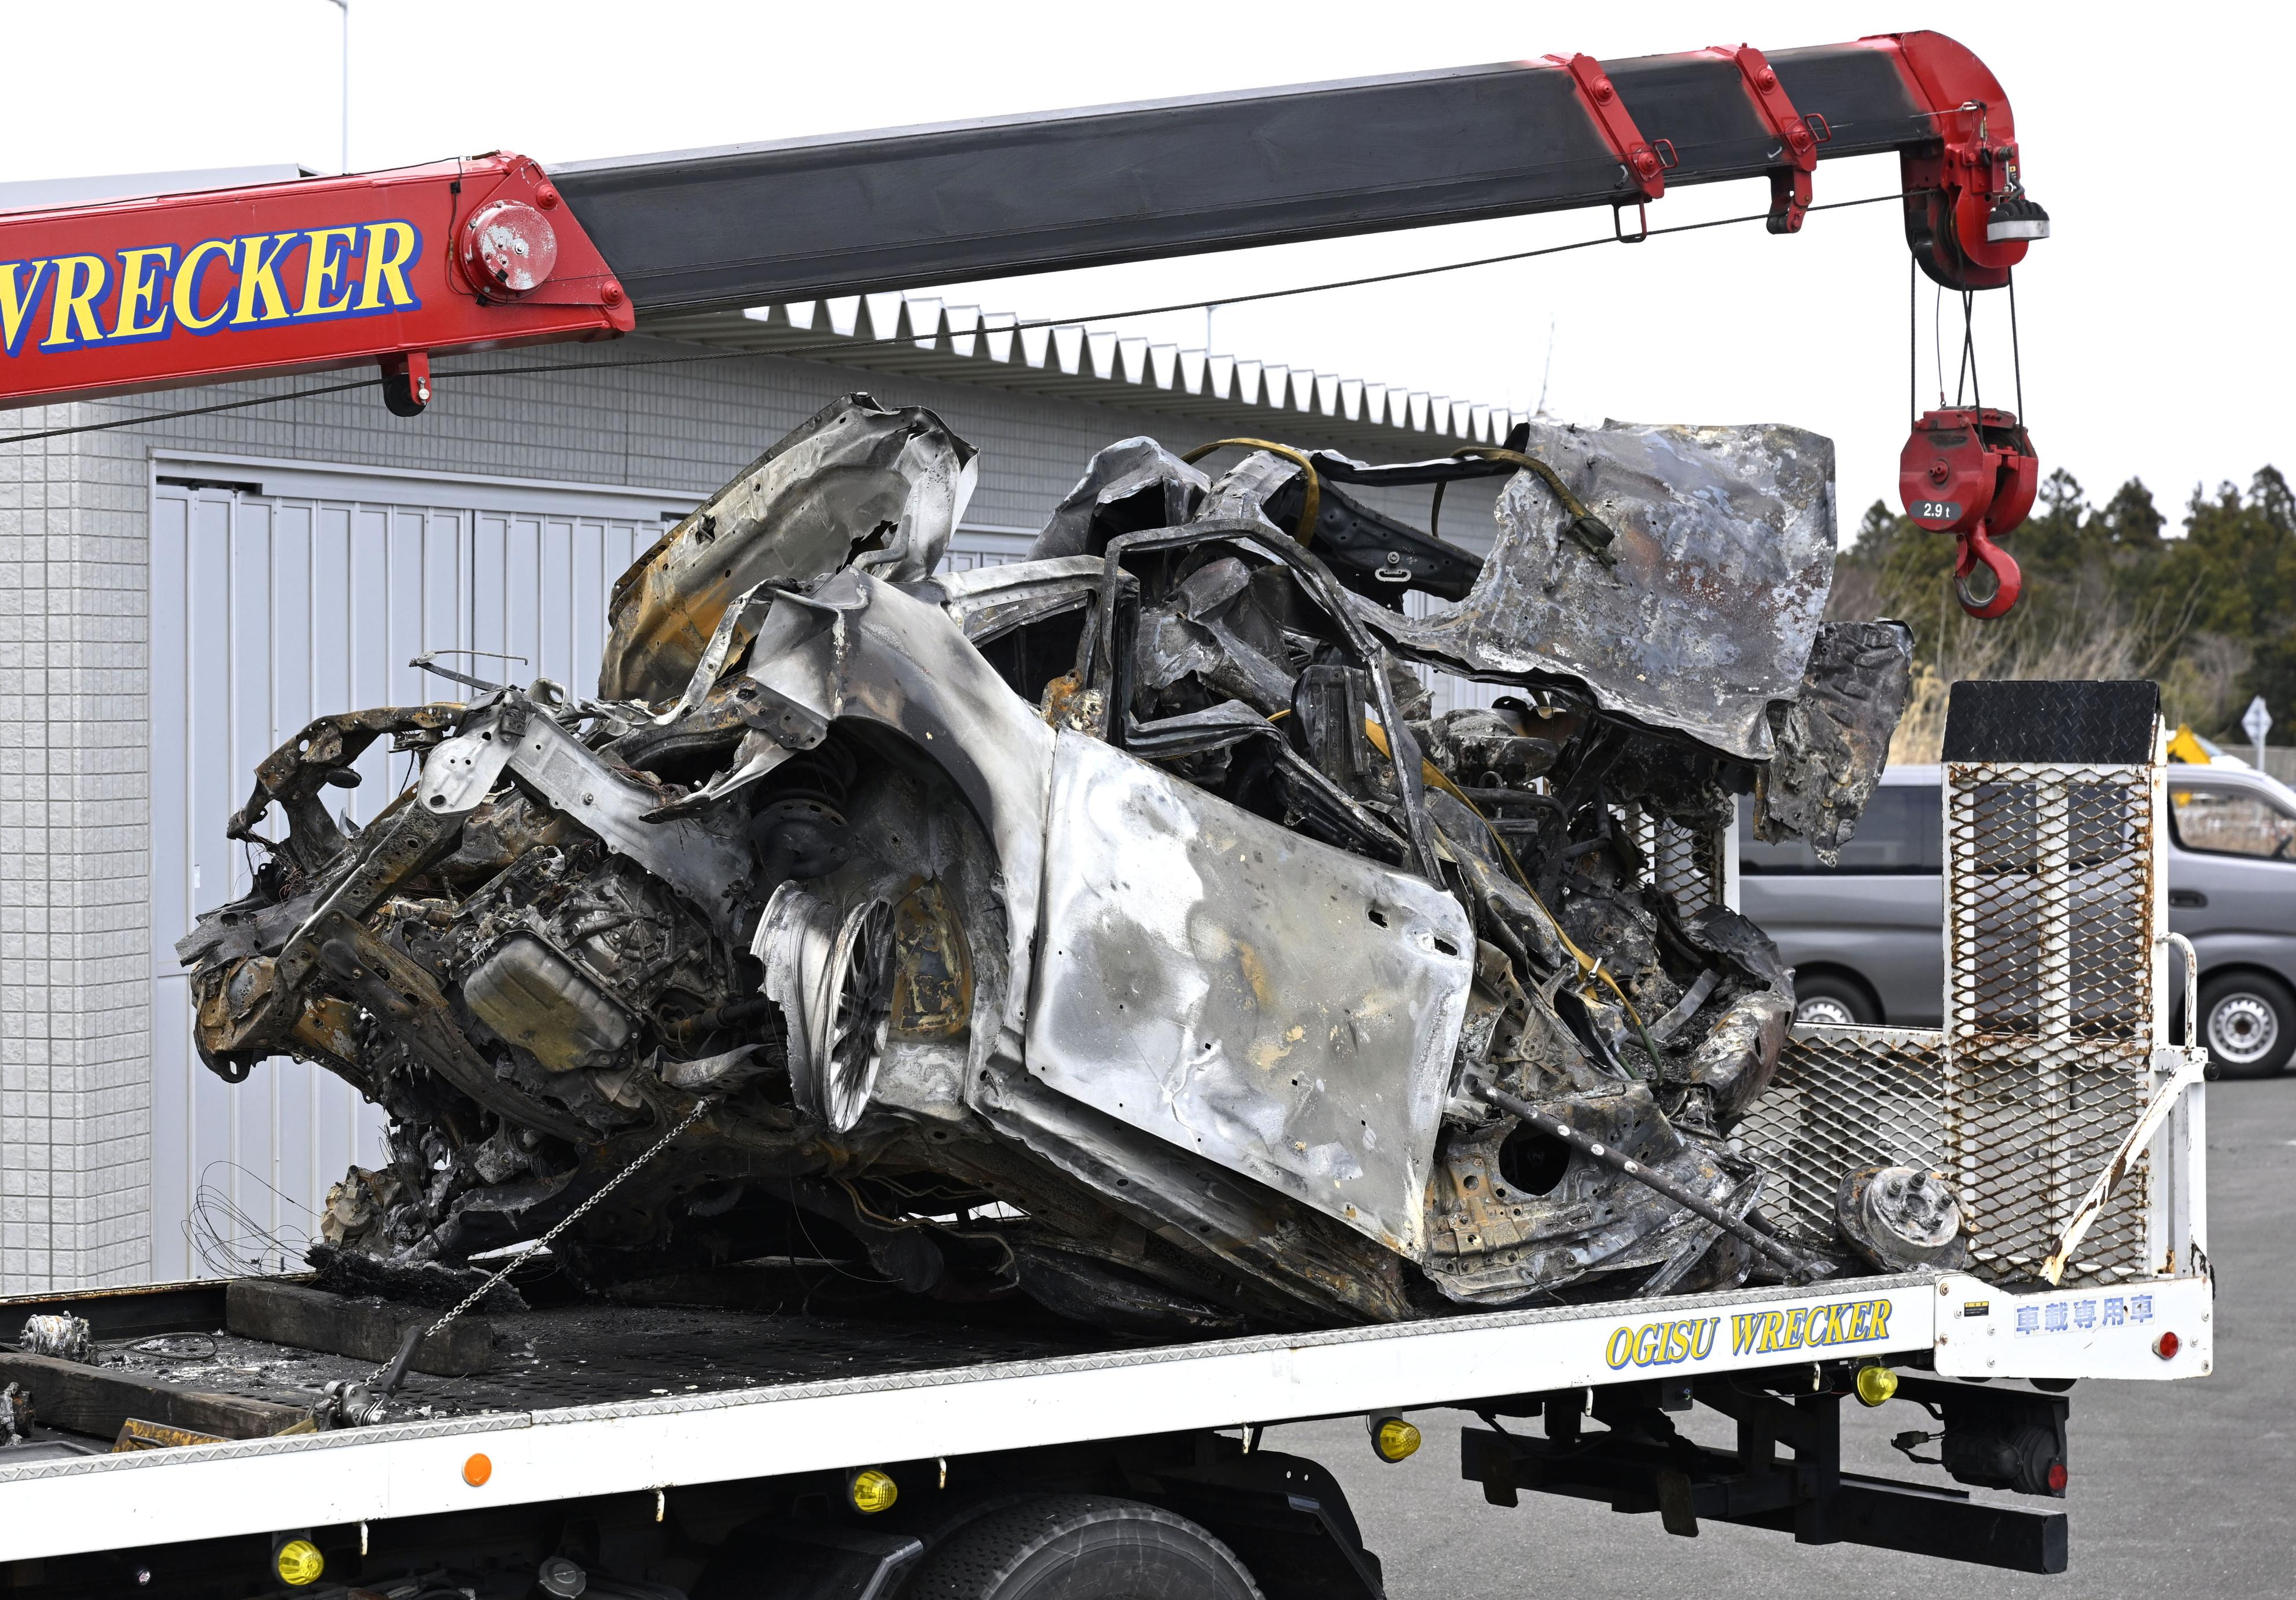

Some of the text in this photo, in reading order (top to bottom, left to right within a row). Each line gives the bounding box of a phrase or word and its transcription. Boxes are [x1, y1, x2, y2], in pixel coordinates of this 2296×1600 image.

[0, 219, 422, 357] WRECKER
[1606, 1299, 1892, 1370] OGISU WRECKER
[2016, 1295, 2152, 1334] 車載専用車
